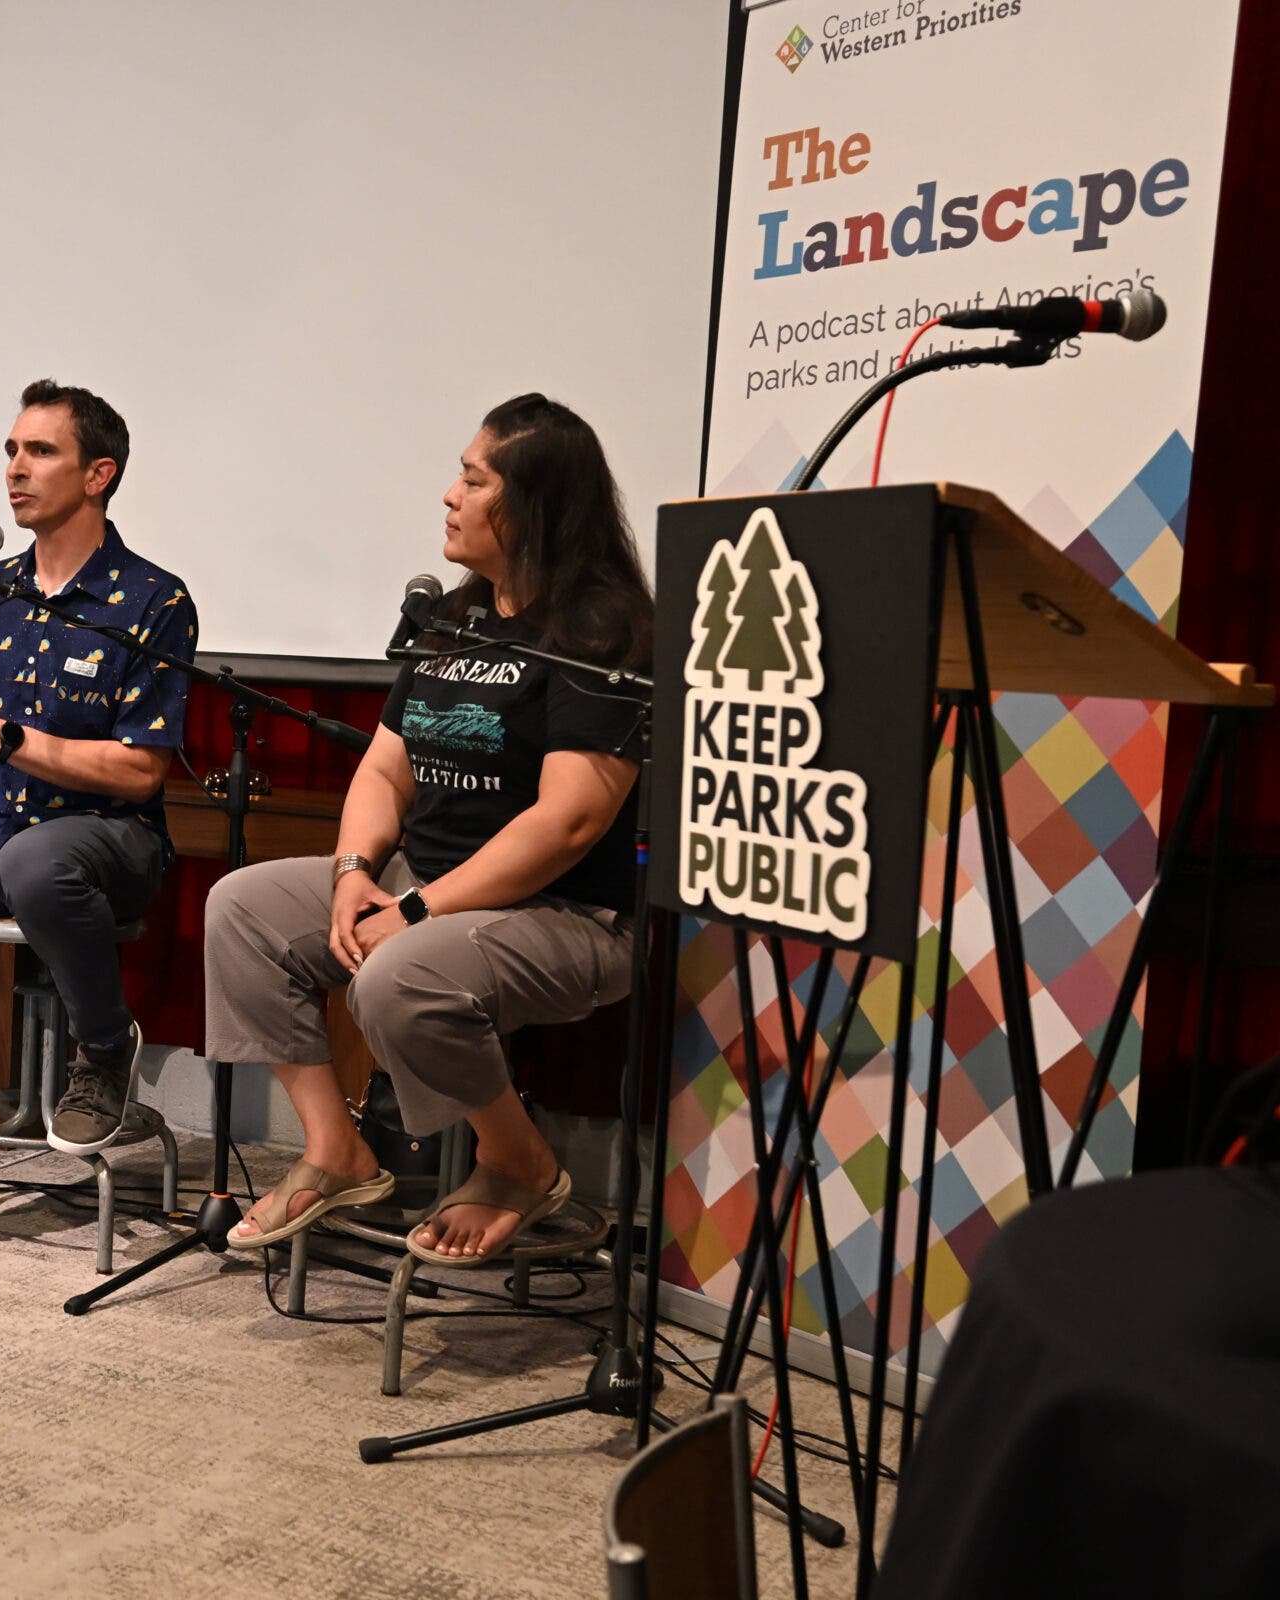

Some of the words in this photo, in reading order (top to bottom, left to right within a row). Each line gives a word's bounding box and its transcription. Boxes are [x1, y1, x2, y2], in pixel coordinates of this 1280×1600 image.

[820, 29, 906, 64] Western
[915, 0, 1021, 41] Priorities
[823, 7, 889, 39] Center
[763, 126, 871, 191] The
[753, 158, 1190, 281] Landscape
[749, 320, 769, 348] A
[776, 304, 885, 353] podcast
[895, 291, 983, 330] about
[746, 360, 818, 399] parks
[825, 349, 879, 383] and
[463, 660, 527, 684] EARS
[693, 699, 810, 767] KEEP
[413, 764, 500, 791] ALITION
[690, 766, 855, 849] PARKS
[687, 832, 859, 923] PUBLIC
